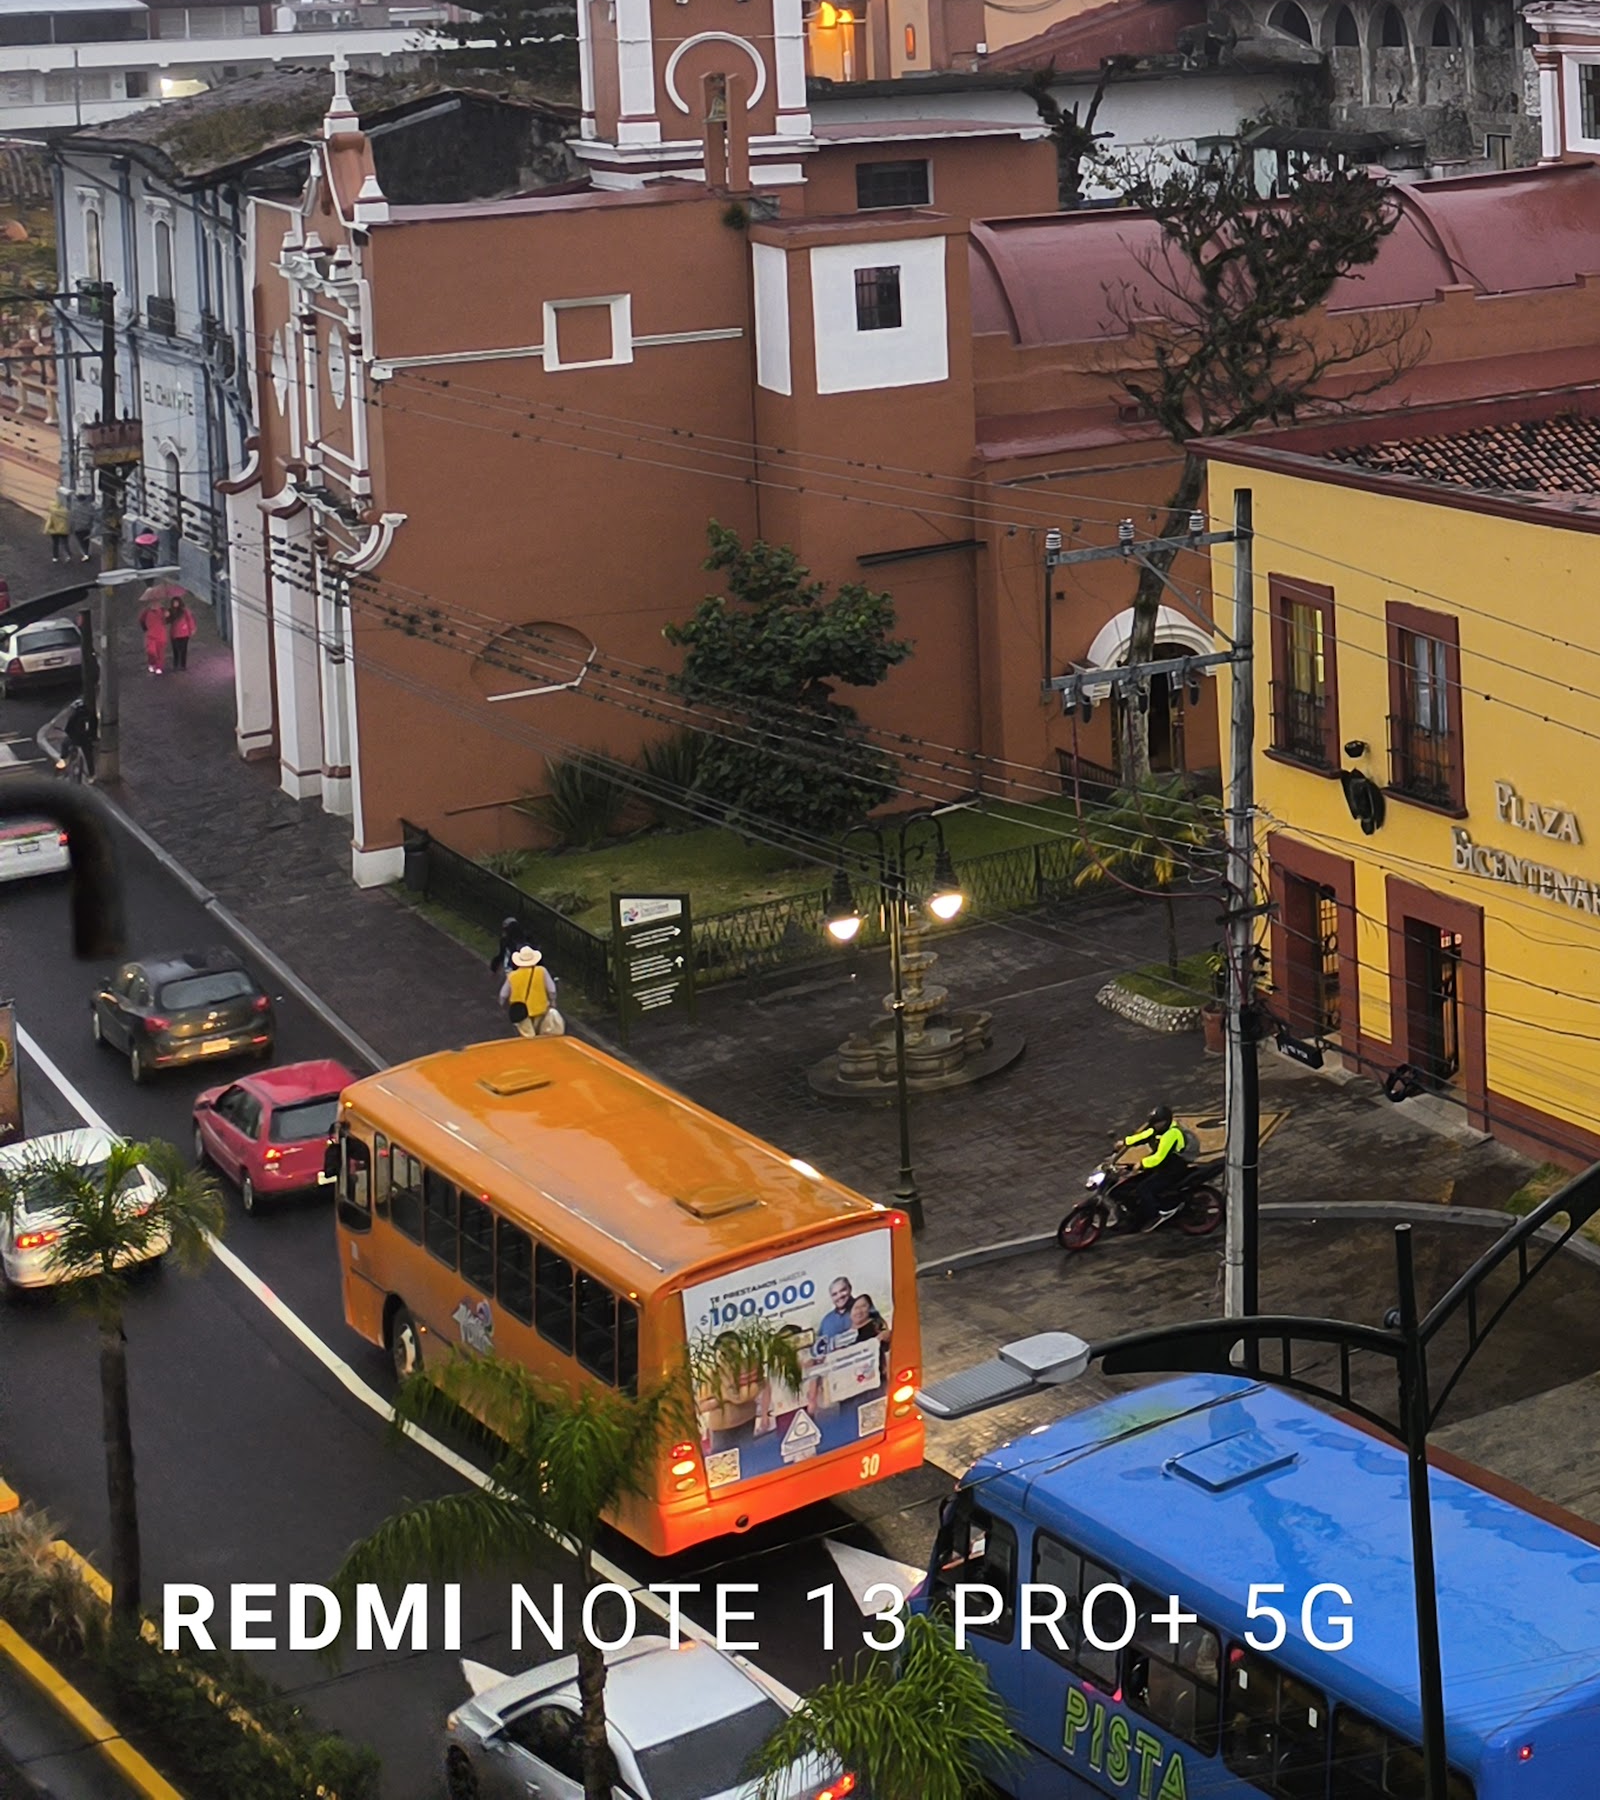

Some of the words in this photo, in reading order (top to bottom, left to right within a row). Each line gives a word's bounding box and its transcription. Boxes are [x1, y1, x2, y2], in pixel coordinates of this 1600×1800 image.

[1494, 779, 1583, 846] PLAZA
[700, 1279, 815, 1326] $100,000
[859, 1453, 880, 1479] 30
[1062, 1686, 1188, 1800] PISTA
